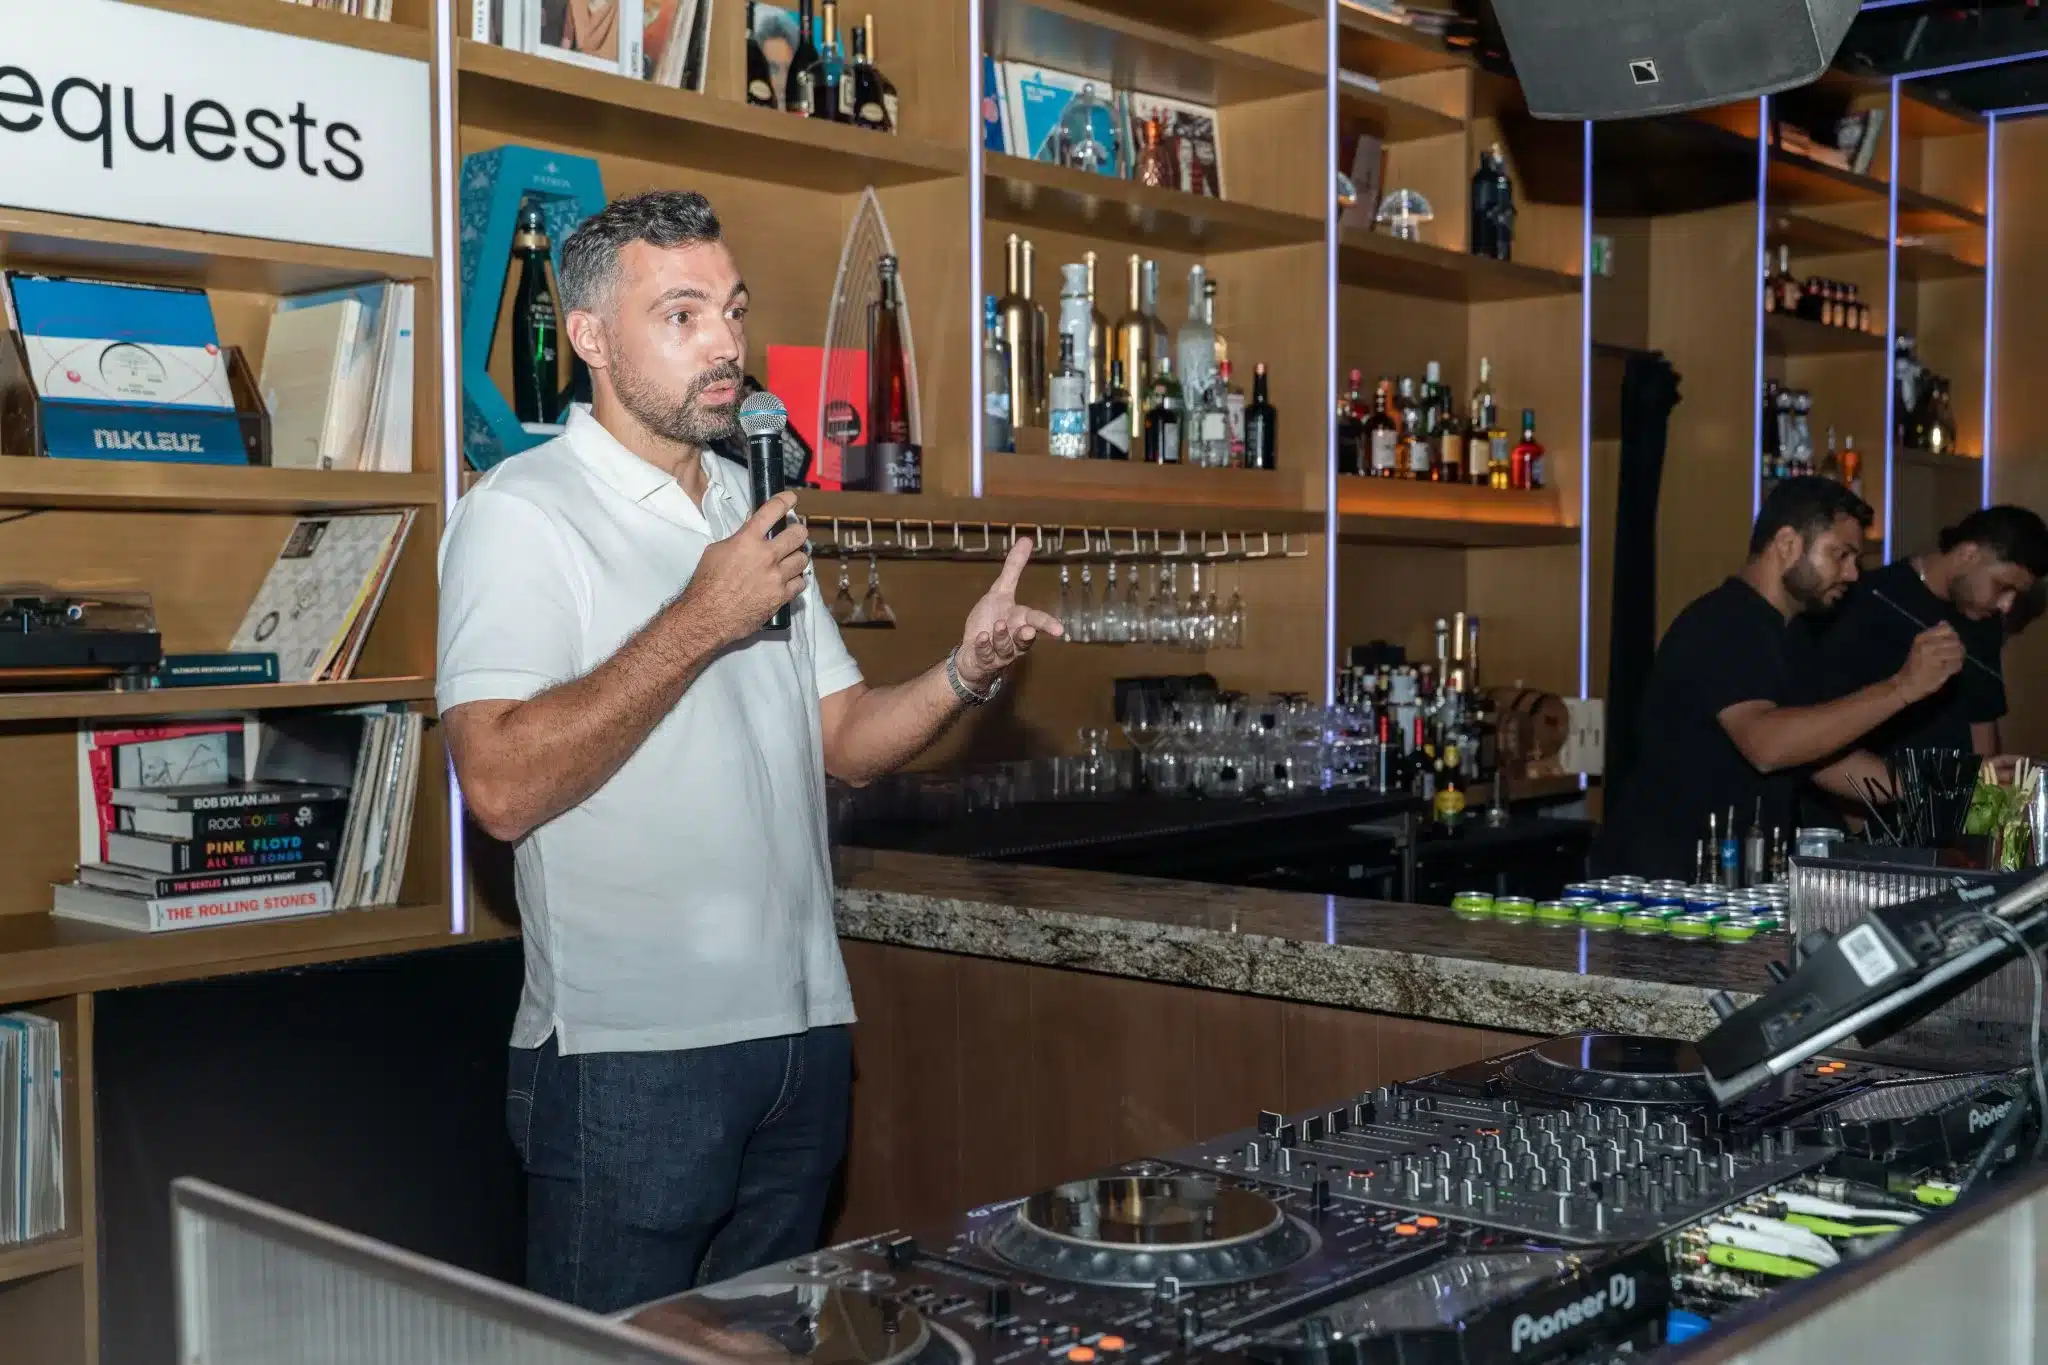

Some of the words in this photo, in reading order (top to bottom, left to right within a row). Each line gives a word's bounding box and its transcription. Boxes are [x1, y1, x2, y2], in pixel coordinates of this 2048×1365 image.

[193, 797, 219, 810] BOB
[219, 793, 257, 808] DYLAN
[208, 816, 242, 831] ROCK
[206, 840, 246, 855] PINK
[252, 836, 302, 852] FLOYD
[206, 857, 228, 869] ALL
[232, 855, 255, 865] THE
[261, 851, 303, 864] SONGS
[174, 882, 189, 893] THE
[191, 879, 222, 890] BEATLES
[223, 878, 230, 887] A
[231, 877, 251, 887] HARD
[252, 873, 272, 885] DAY'S
[273, 871, 297, 882] NIGHT
[166, 906, 194, 921] THE
[198, 898, 260, 919] ROLLING
[264, 892, 317, 911] STONES
[1511, 1289, 1608, 1354] Pioneer
